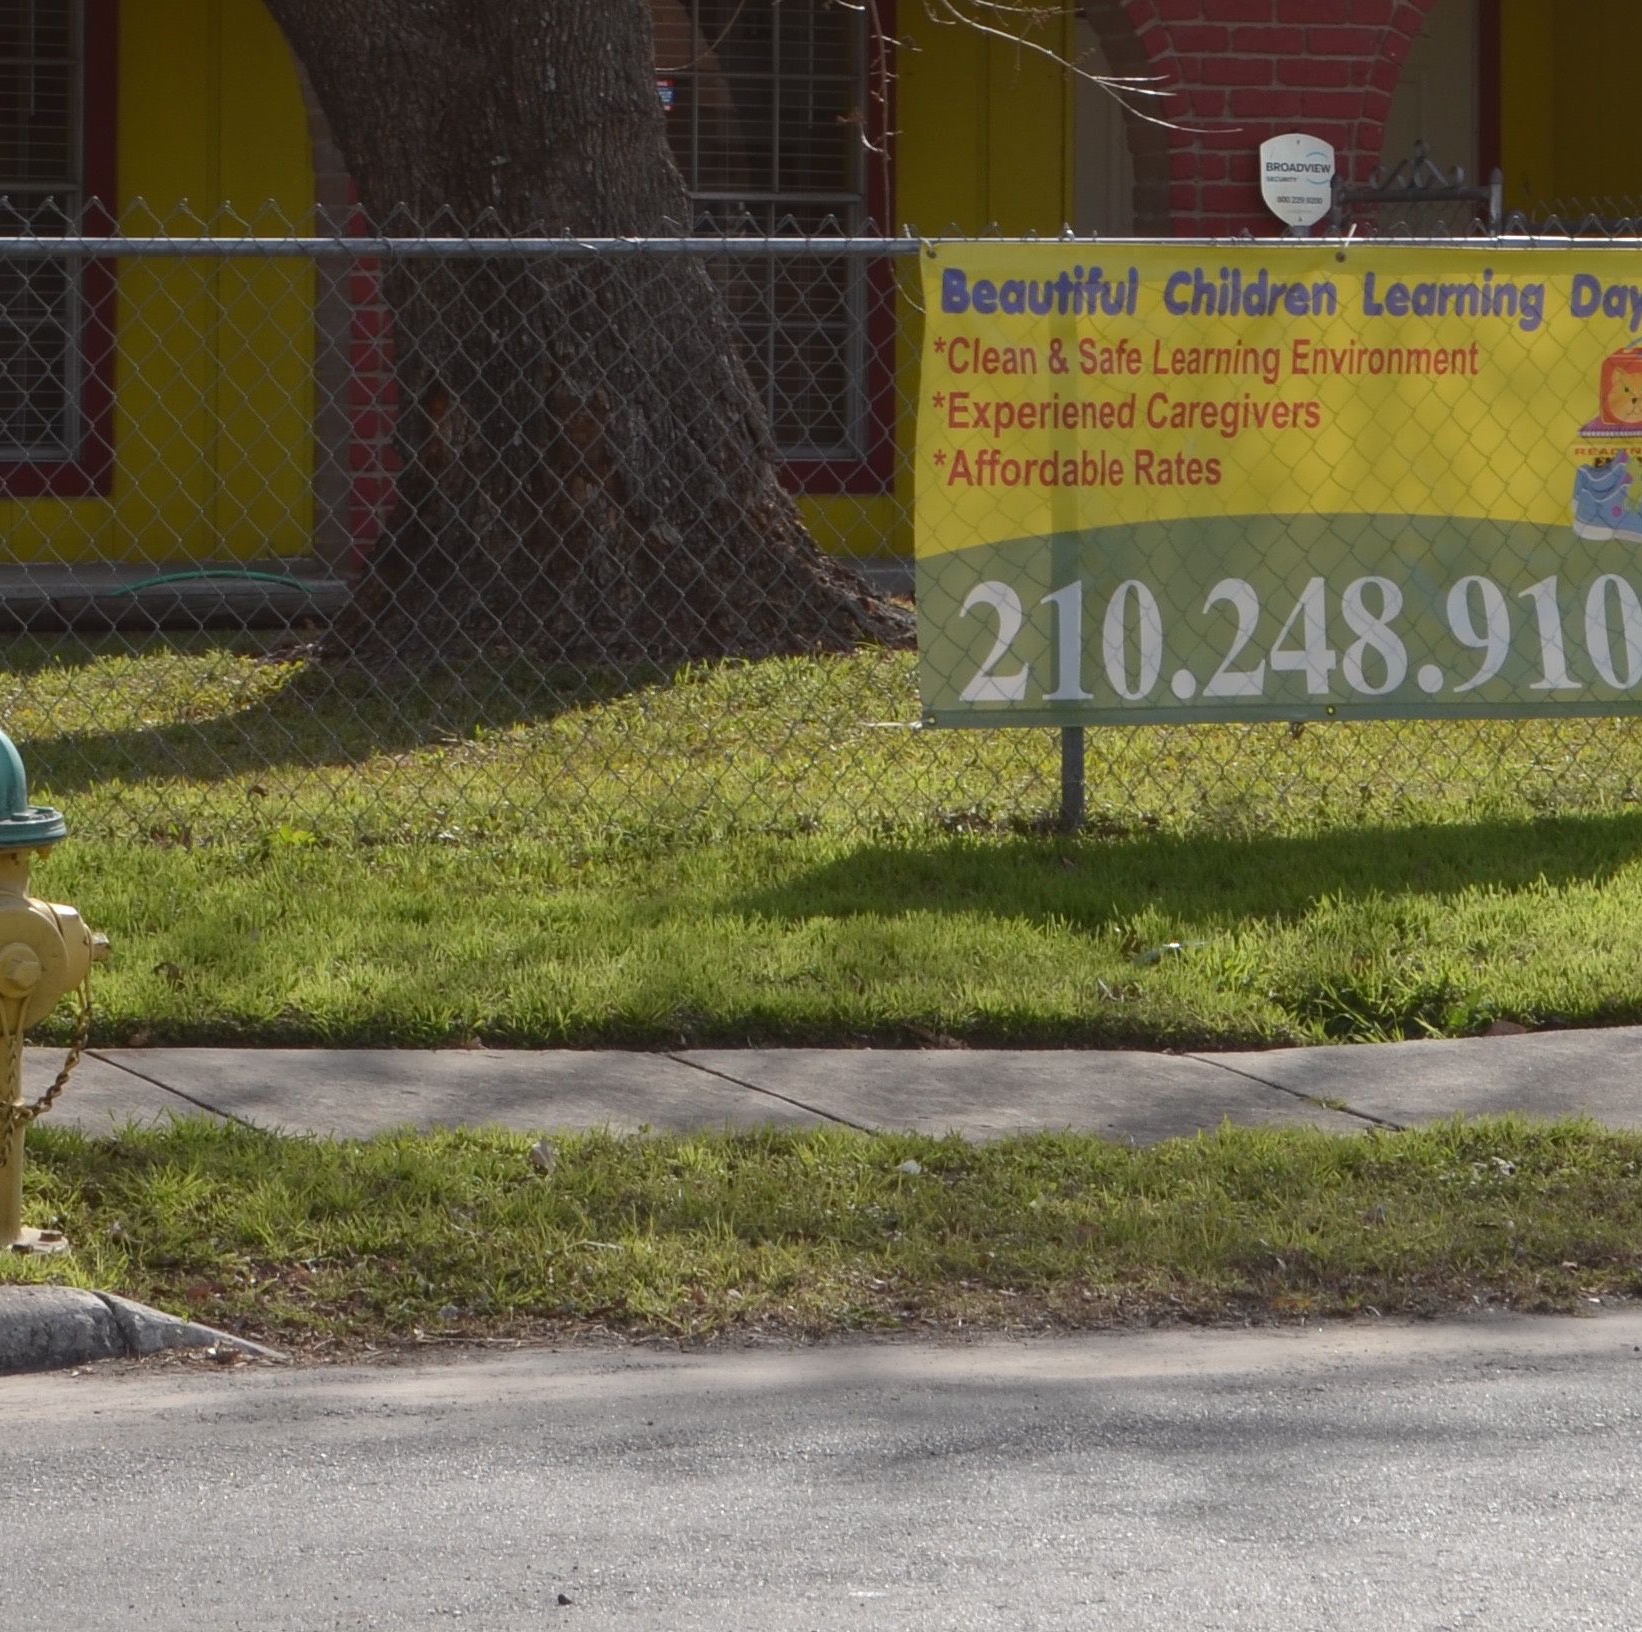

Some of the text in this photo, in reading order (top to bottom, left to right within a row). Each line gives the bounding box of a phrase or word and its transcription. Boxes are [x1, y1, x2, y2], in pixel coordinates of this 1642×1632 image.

[1266, 161, 1332, 174] BROADVIEW
[940, 264, 1140, 317] Beautiful
[1163, 266, 1339, 317] Children
[1362, 267, 1547, 333] Learning
[1048, 337, 1070, 376] &
[1079, 337, 1143, 376] Safe
[1152, 338, 1281, 385] Learning
[1291, 338, 1480, 376] Environment
[1146, 391, 1322, 439] Caregivers
[1134, 448, 1223, 486] Rates
